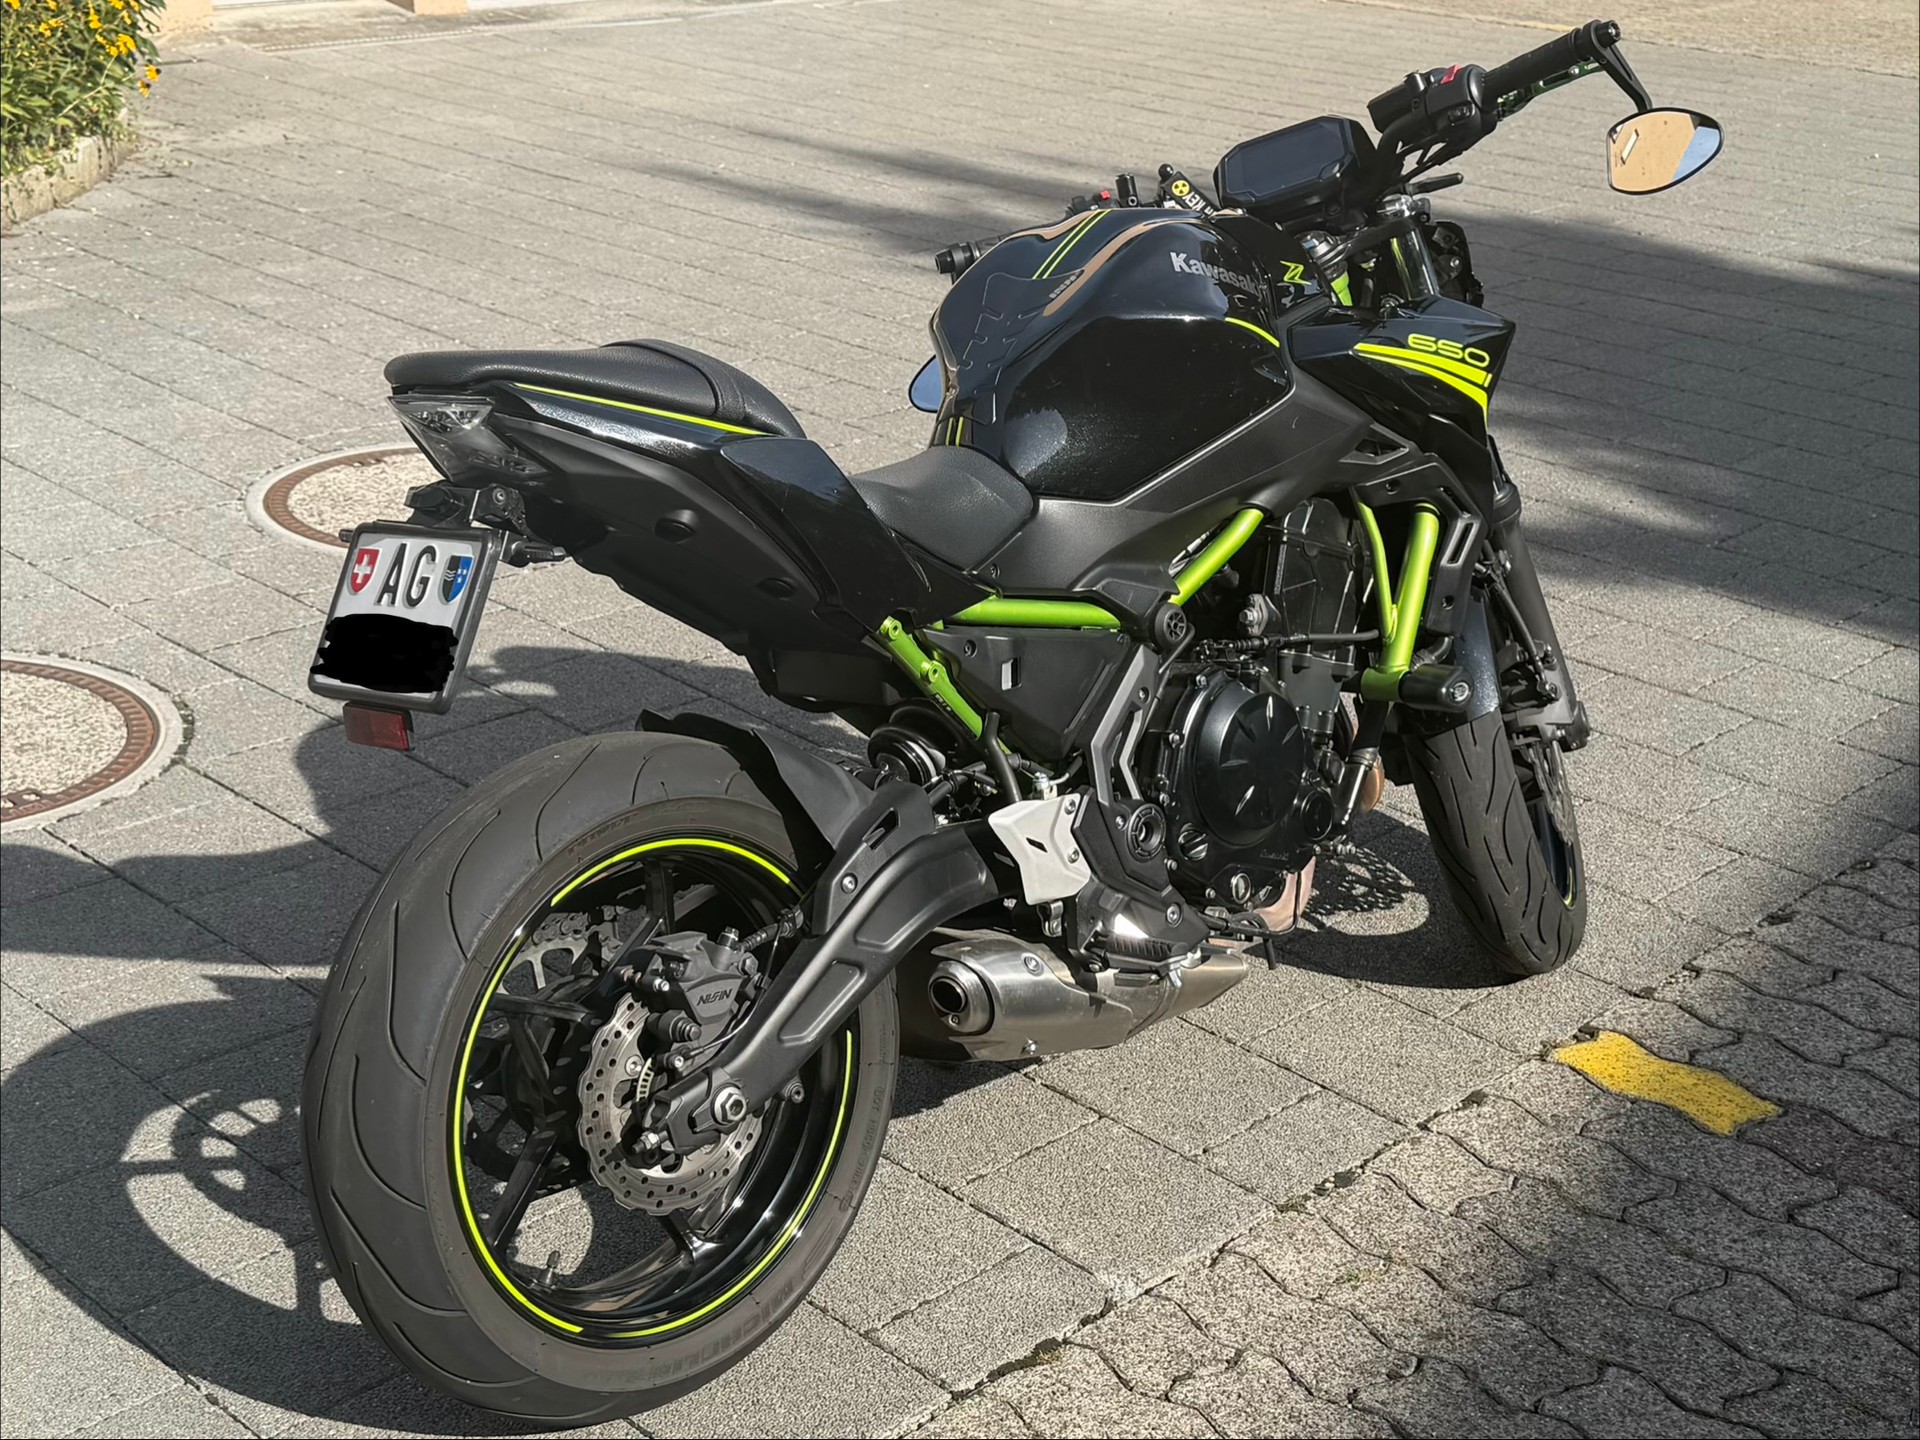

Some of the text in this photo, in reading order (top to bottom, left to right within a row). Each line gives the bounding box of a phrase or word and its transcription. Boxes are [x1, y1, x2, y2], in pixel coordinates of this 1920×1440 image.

[1182, 191, 1207, 213] KEY
[1169, 252, 1262, 298] Kawasaki
[1407, 333, 1490, 368] 650
[376, 543, 437, 608] AG
